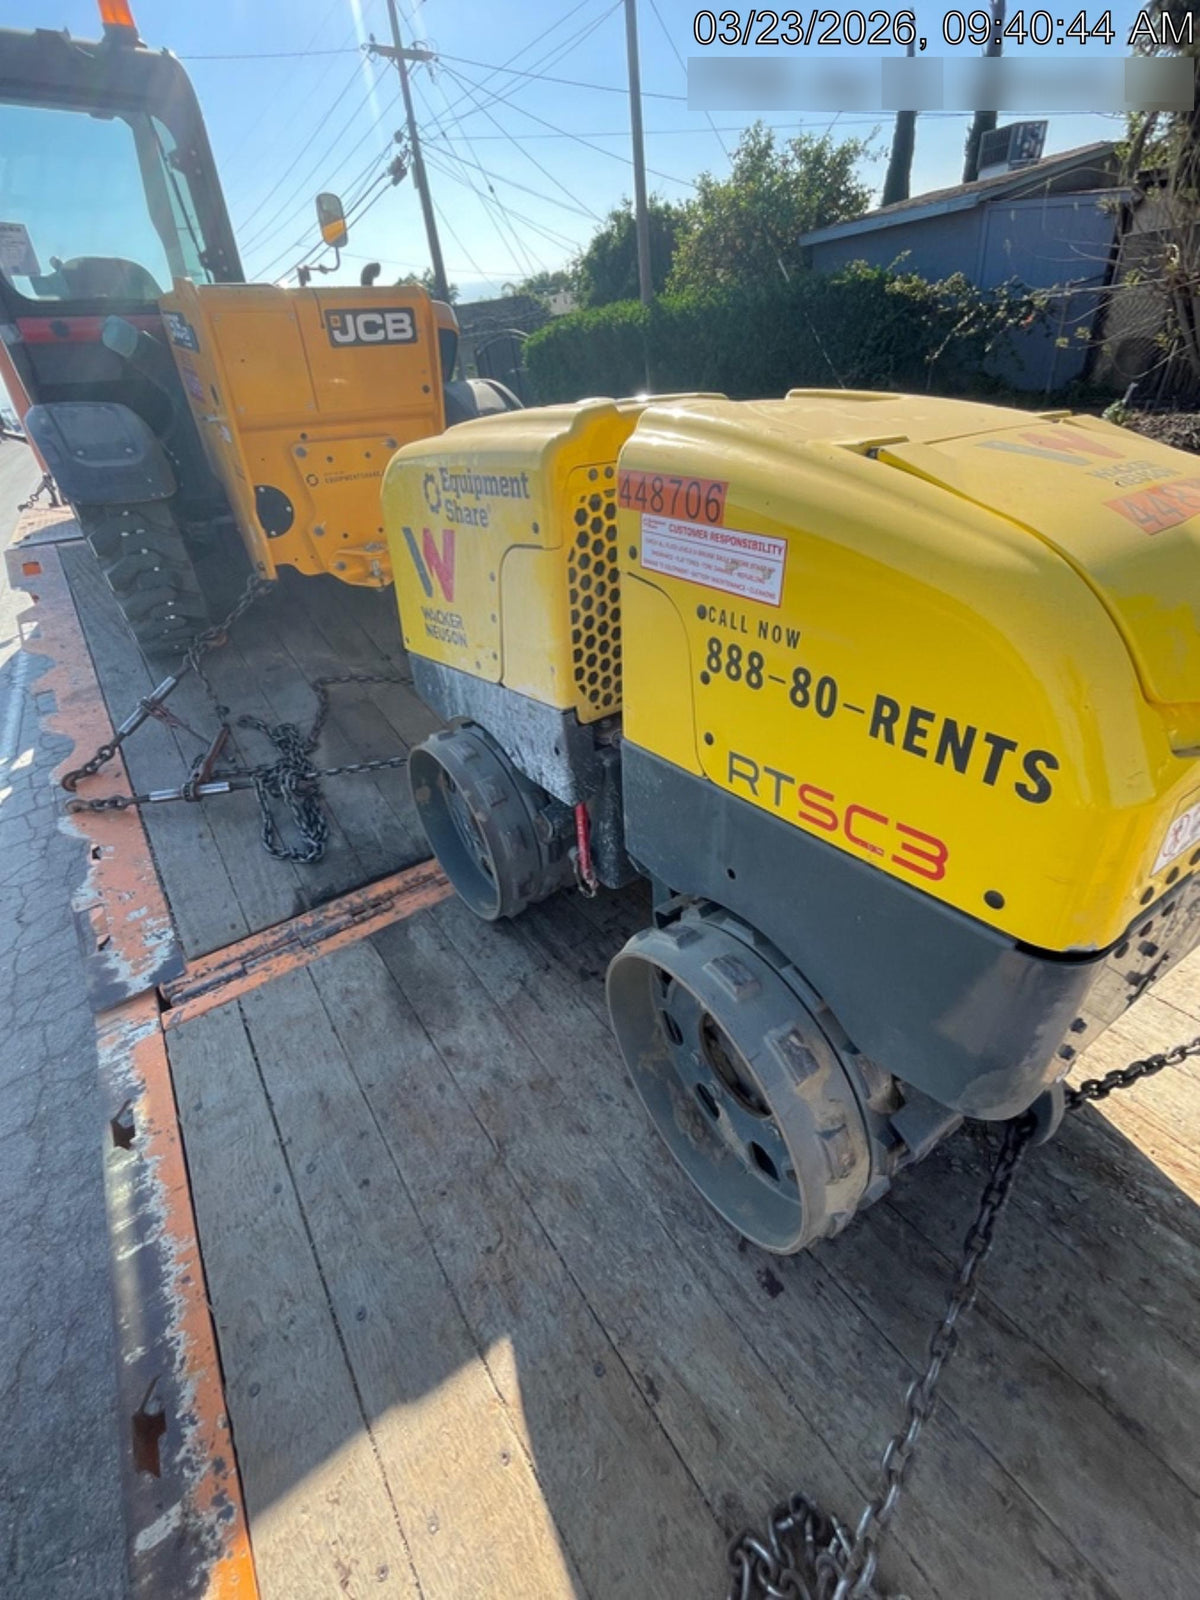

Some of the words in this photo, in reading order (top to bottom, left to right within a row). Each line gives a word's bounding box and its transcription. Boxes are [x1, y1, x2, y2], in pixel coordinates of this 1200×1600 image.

[330, 312, 414, 343] JCB
[439, 467, 531, 500] Equipment
[619, 473, 723, 523] 448706
[444, 499, 490, 527] Share
[668, 523, 708, 539] CUSTOMER
[710, 532, 784, 556] RESPONSIBILITY
[420, 606, 464, 630] WACKER
[708, 606, 748, 634] CALL
[758, 620, 801, 650] NOW
[425, 623, 469, 648] NEUSON
[706, 637, 1060, 804] 888-80-RENTS
[728, 751, 949, 881] RTSC3
